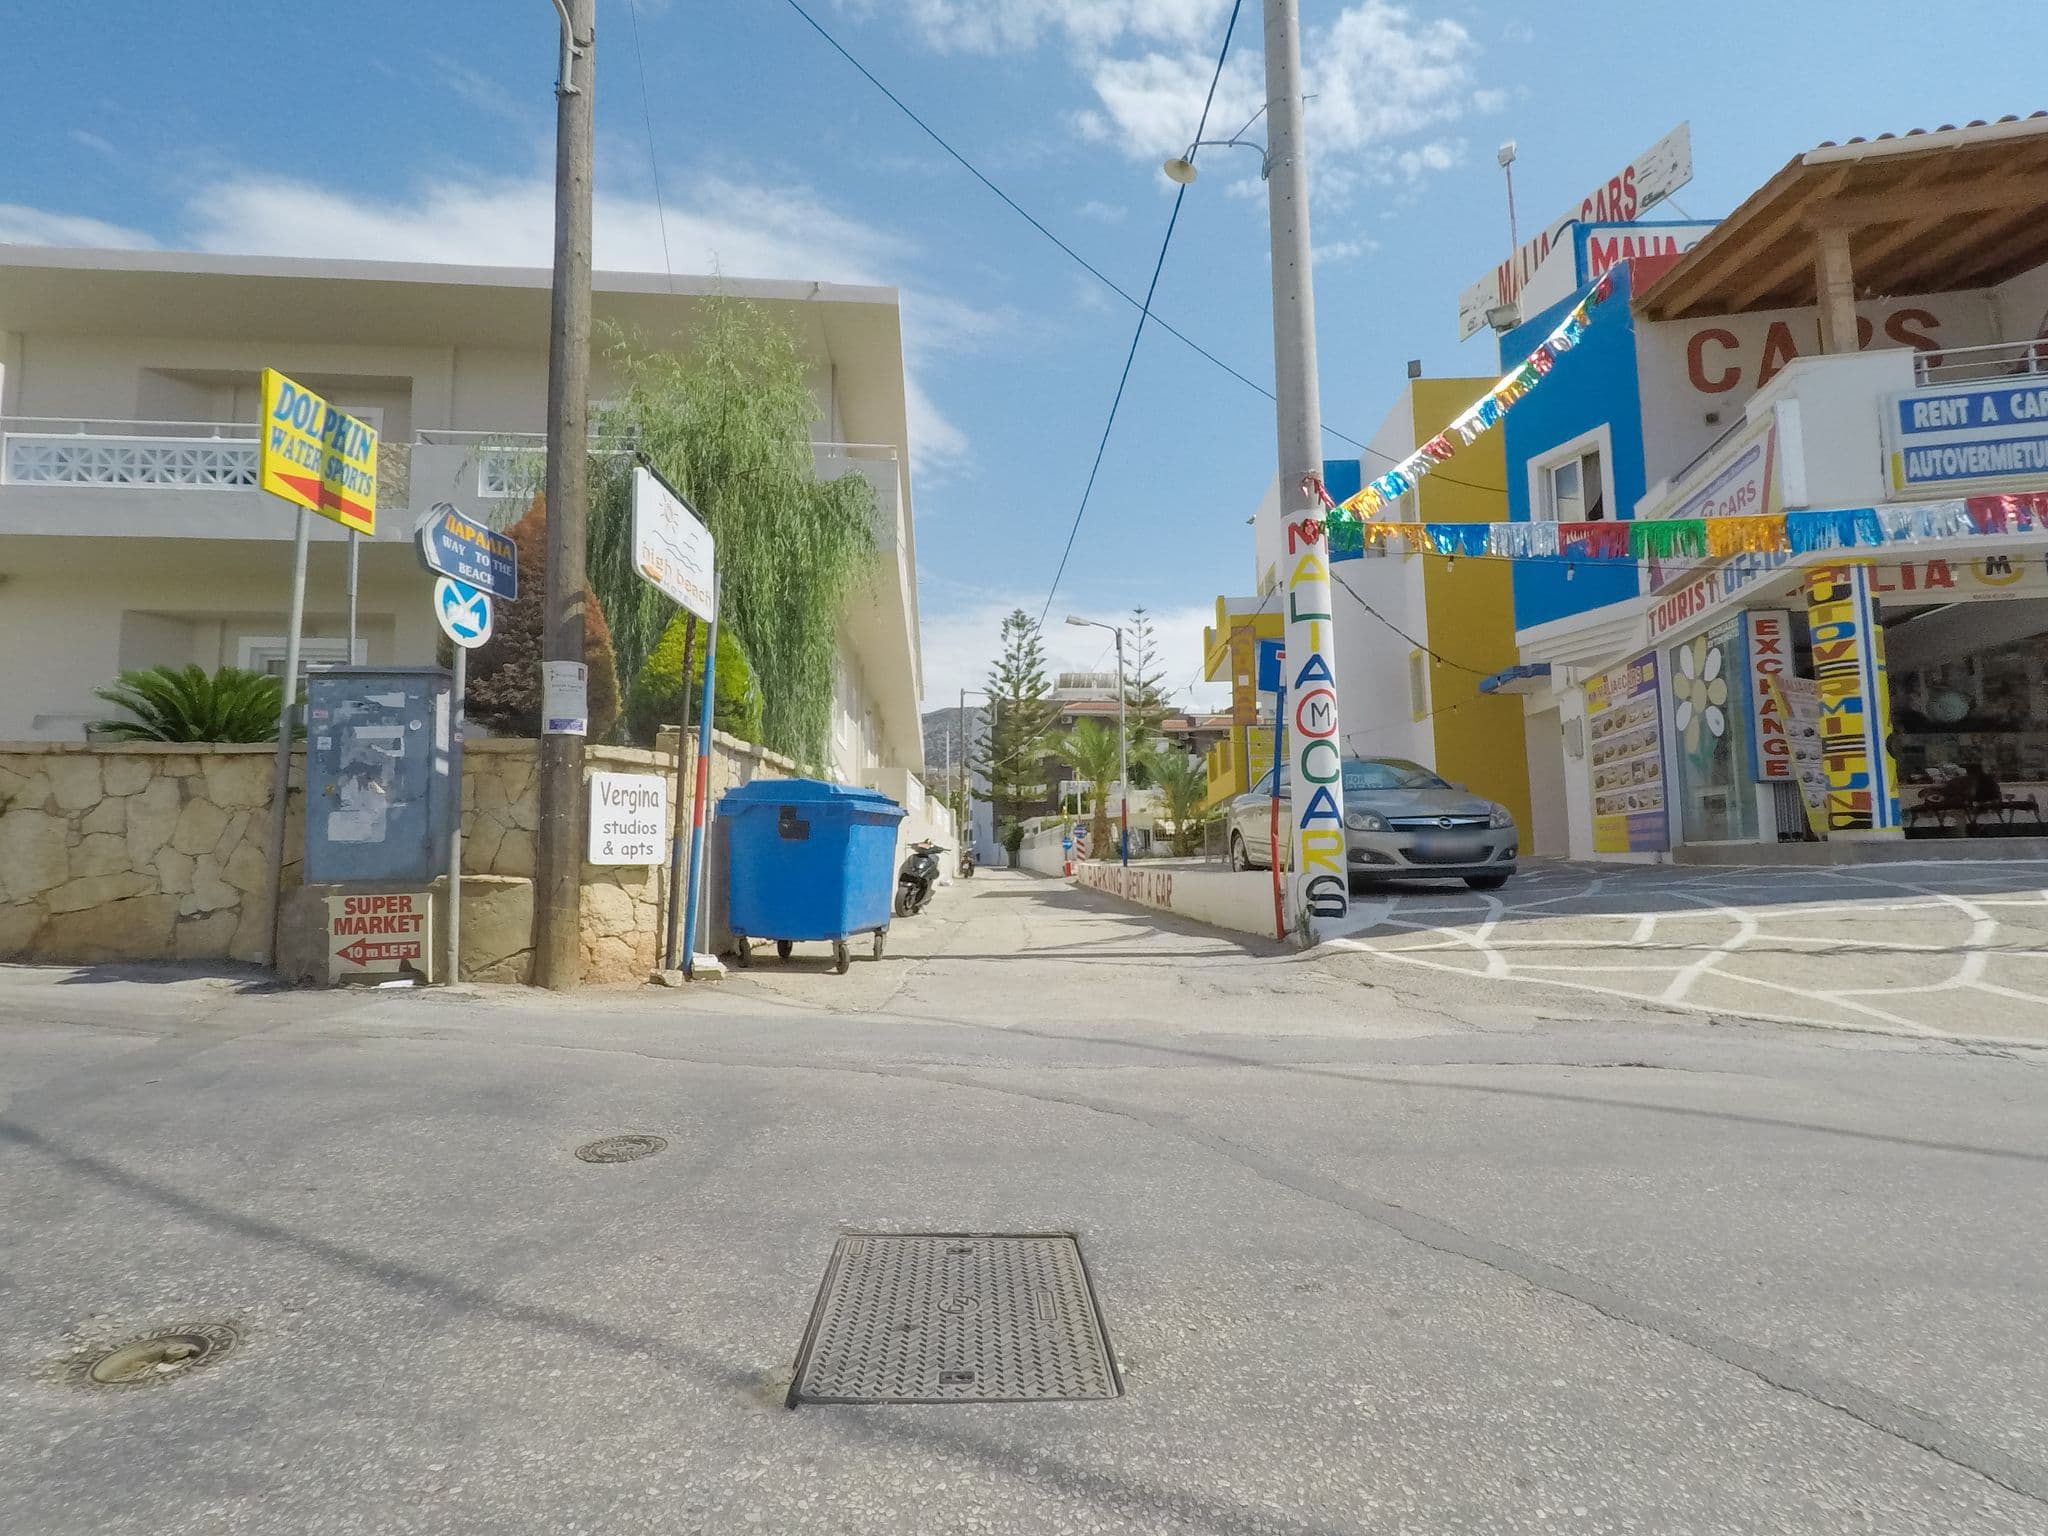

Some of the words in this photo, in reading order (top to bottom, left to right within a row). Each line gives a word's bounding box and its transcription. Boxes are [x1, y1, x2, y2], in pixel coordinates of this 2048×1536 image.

[1581, 165, 1637, 223] CARS
[273, 382, 375, 465] DOLPHIN
[1913, 397, 1969, 428] RENT
[1982, 396, 1999, 422] A
[270, 425, 321, 473] WATER
[325, 456, 372, 497] SPORTS
[442, 534, 466, 556] WAY
[475, 551, 491, 567] TO
[492, 559, 512, 577] THE
[458, 561, 495, 587] BEACH
[1648, 572, 1717, 638] TOURIST
[600, 780, 659, 815] Vergina
[602, 819, 657, 836] studios
[1299, 739, 1347, 919] CARS
[602, 841, 615, 856] &
[621, 842, 655, 858] apts
[343, 895, 412, 914] SUPER
[1156, 873, 1173, 908] CAR
[333, 914, 424, 936] MARKET
[347, 945, 364, 959] 10
[381, 943, 418, 958] LEFT
